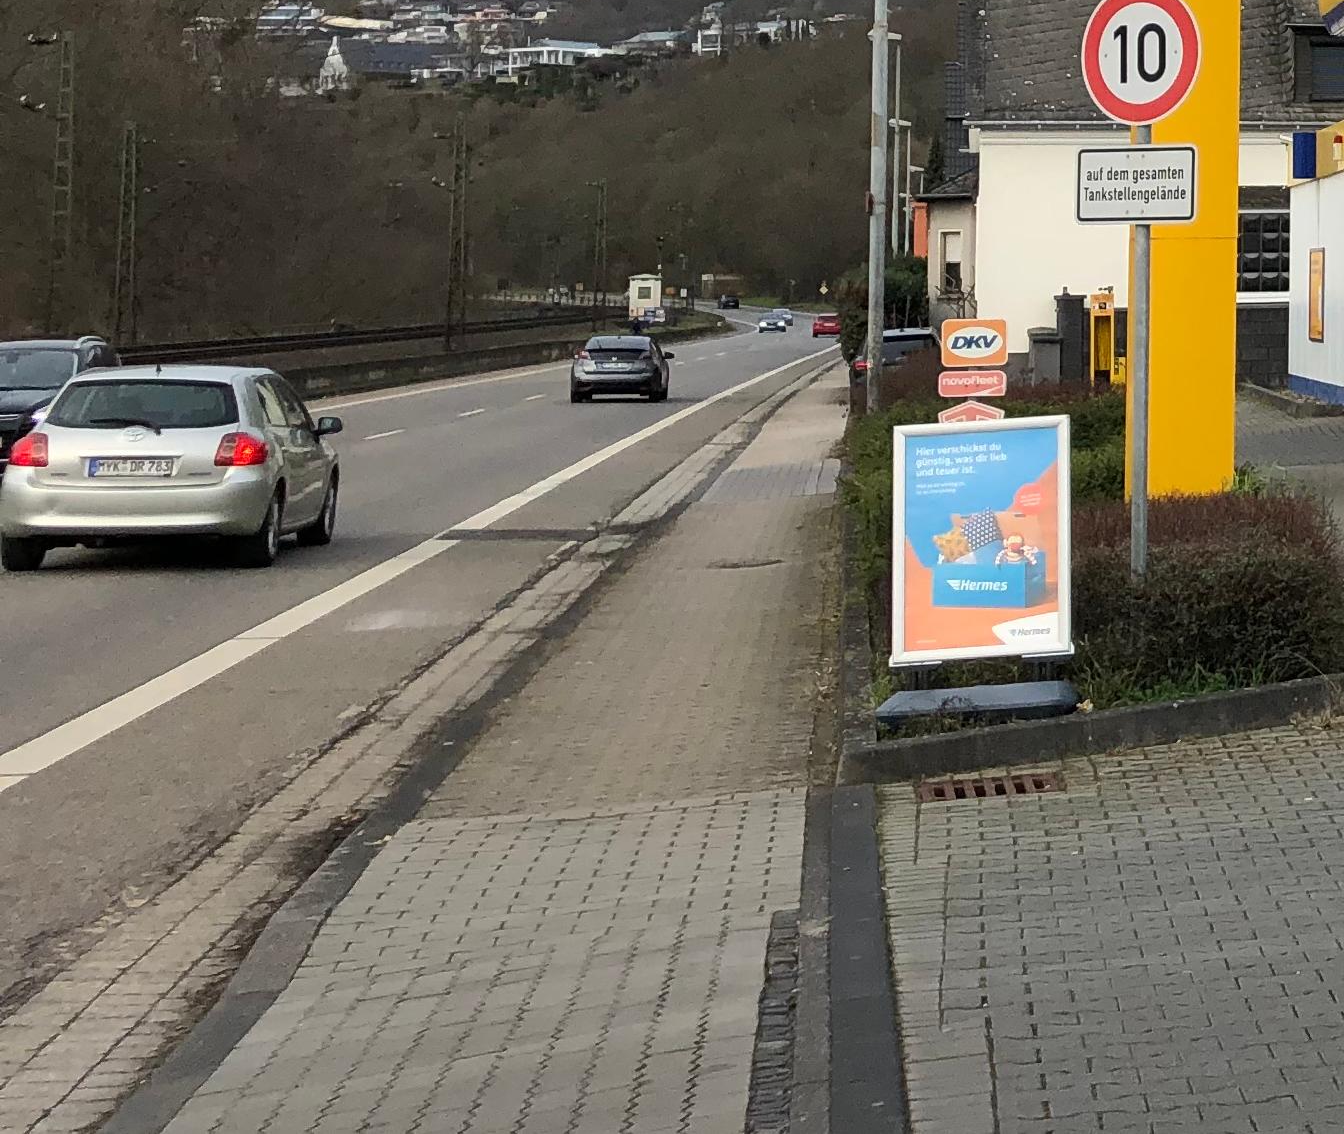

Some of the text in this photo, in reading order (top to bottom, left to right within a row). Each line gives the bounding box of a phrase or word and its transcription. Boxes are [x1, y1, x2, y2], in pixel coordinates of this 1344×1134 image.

[1113, 22, 1167, 84] 10
[1086, 167, 1184, 184] auf dem gesamten
[1083, 186, 1187, 204] Tankstellengelände
[951, 335, 998, 350] DKV
[942, 375, 1000, 386] novofleet
[916, 447, 936, 456] Hier
[989, 442, 1001, 452] du
[955, 455, 974, 464] was
[975, 453, 988, 463] dir
[990, 452, 1007, 462] lieb
[148, 460, 171, 472] 783
[916, 467, 934, 477] und
[935, 466, 960, 476] teuer
[960, 579, 1008, 591] Hermes
[1017, 627, 1051, 636] Hermes
